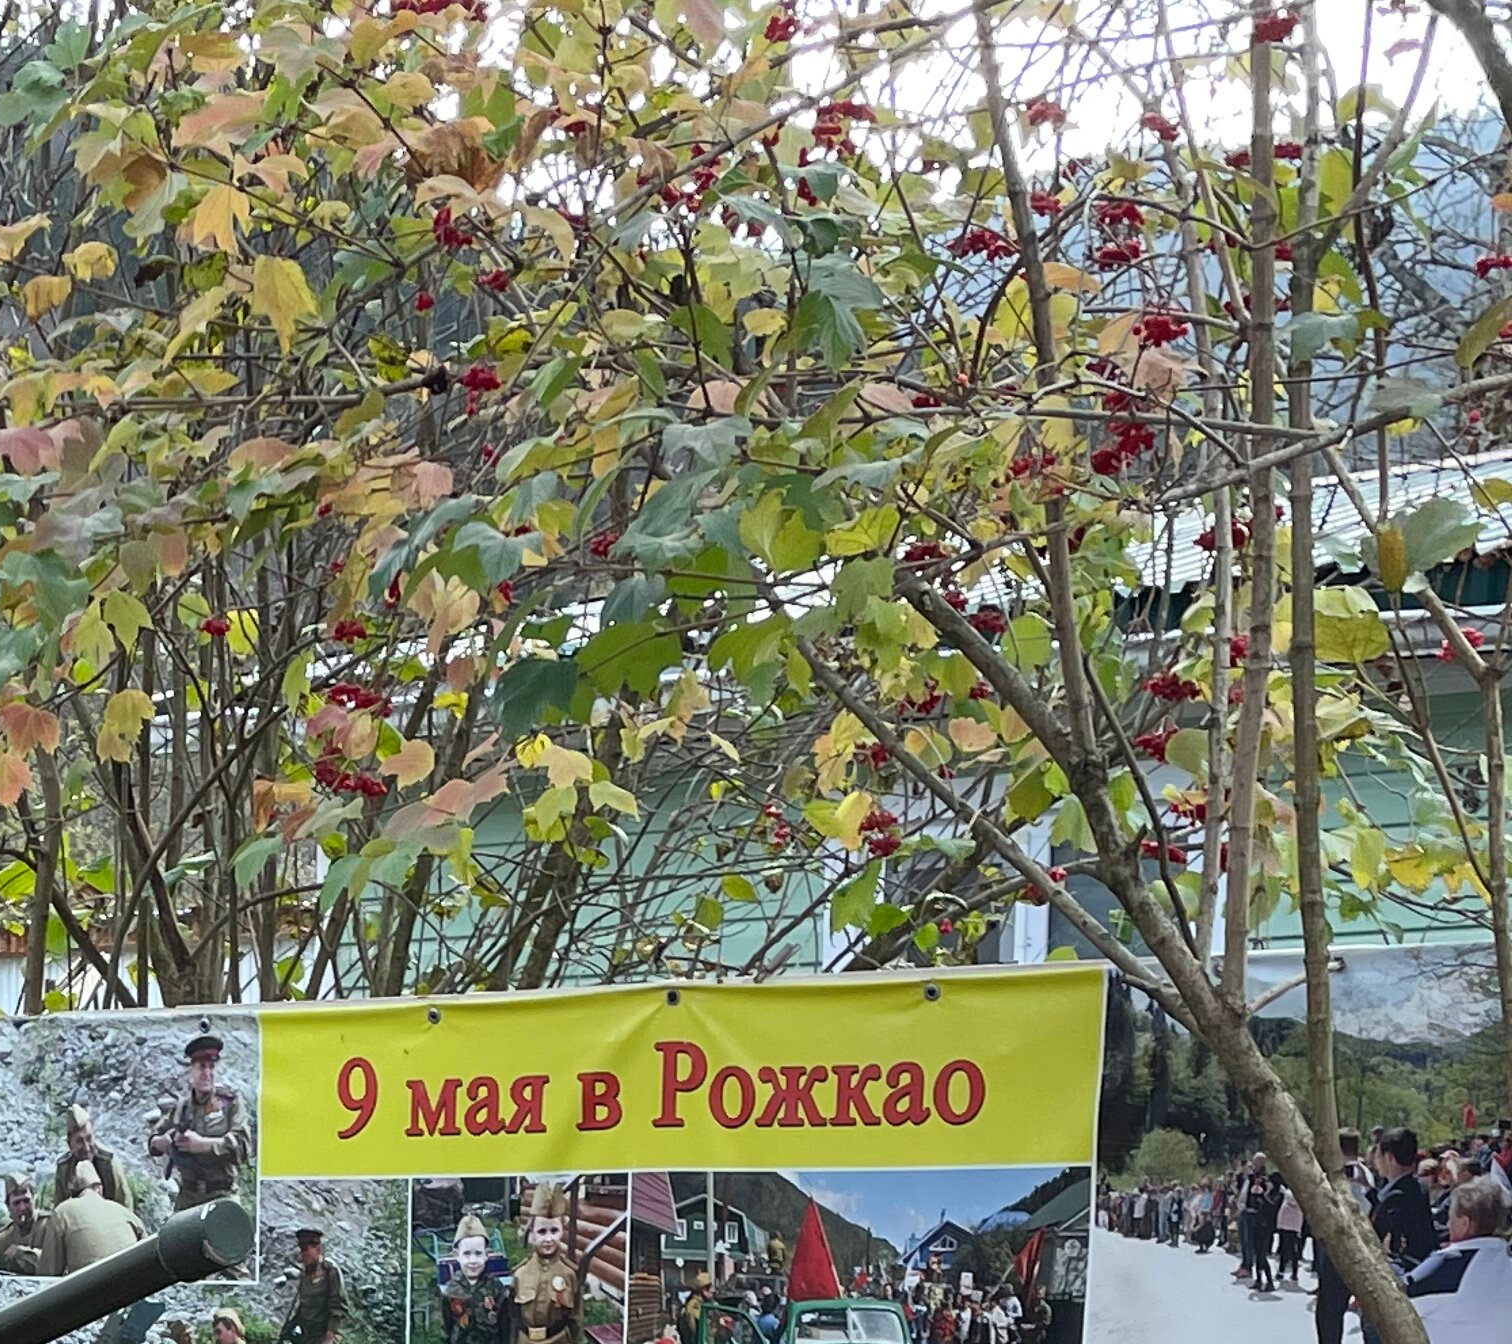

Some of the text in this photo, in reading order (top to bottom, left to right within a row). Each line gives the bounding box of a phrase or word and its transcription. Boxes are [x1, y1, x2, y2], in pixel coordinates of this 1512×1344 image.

[336, 1040, 987, 1140] 9 мая в Рожкао
